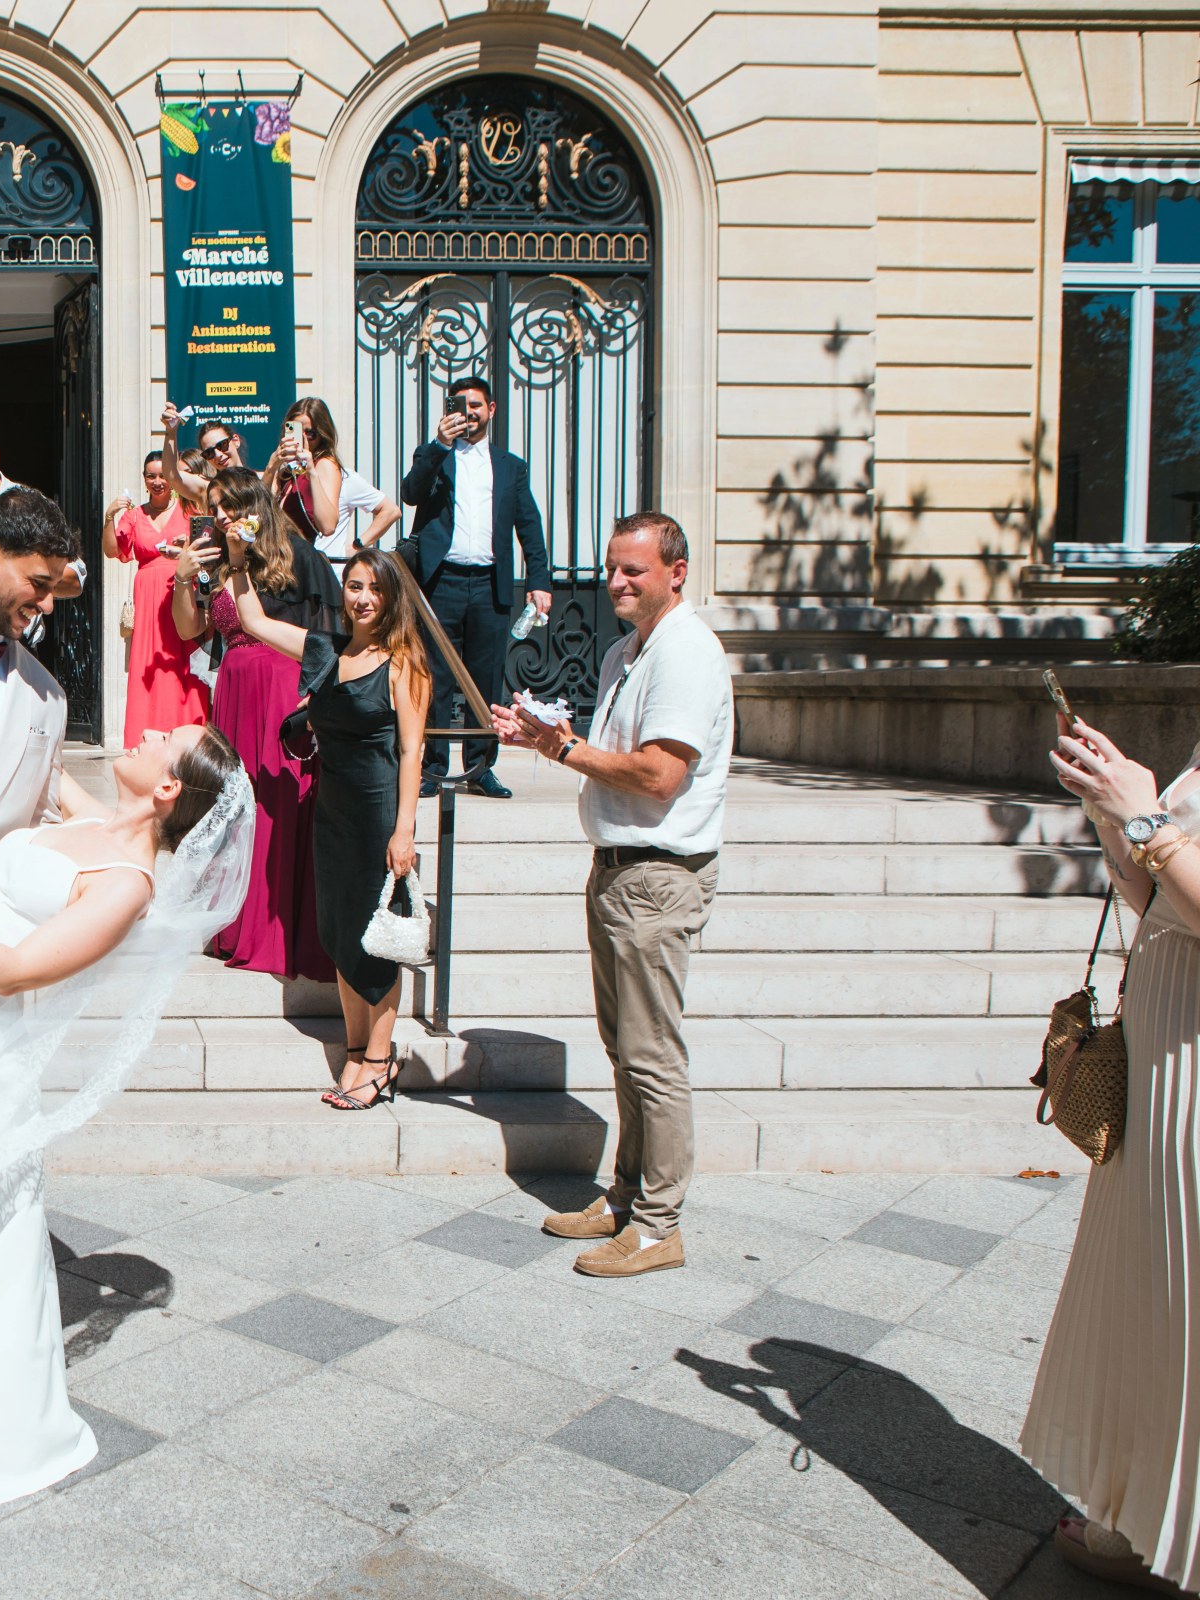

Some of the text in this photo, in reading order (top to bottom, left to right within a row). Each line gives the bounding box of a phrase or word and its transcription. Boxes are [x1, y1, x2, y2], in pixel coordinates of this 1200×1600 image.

[191, 235, 267, 245] Les nocturnes du
[182, 245, 269, 266] Marché
[175, 268, 283, 287] Villeneuve
[223, 307, 238, 321] DJ
[192, 324, 271, 336] Animations
[187, 341, 275, 353] Restauration
[193, 404, 271, 413] Tous les vendredis
[233, 415, 243, 423] 31
[244, 415, 269, 424] juillet
